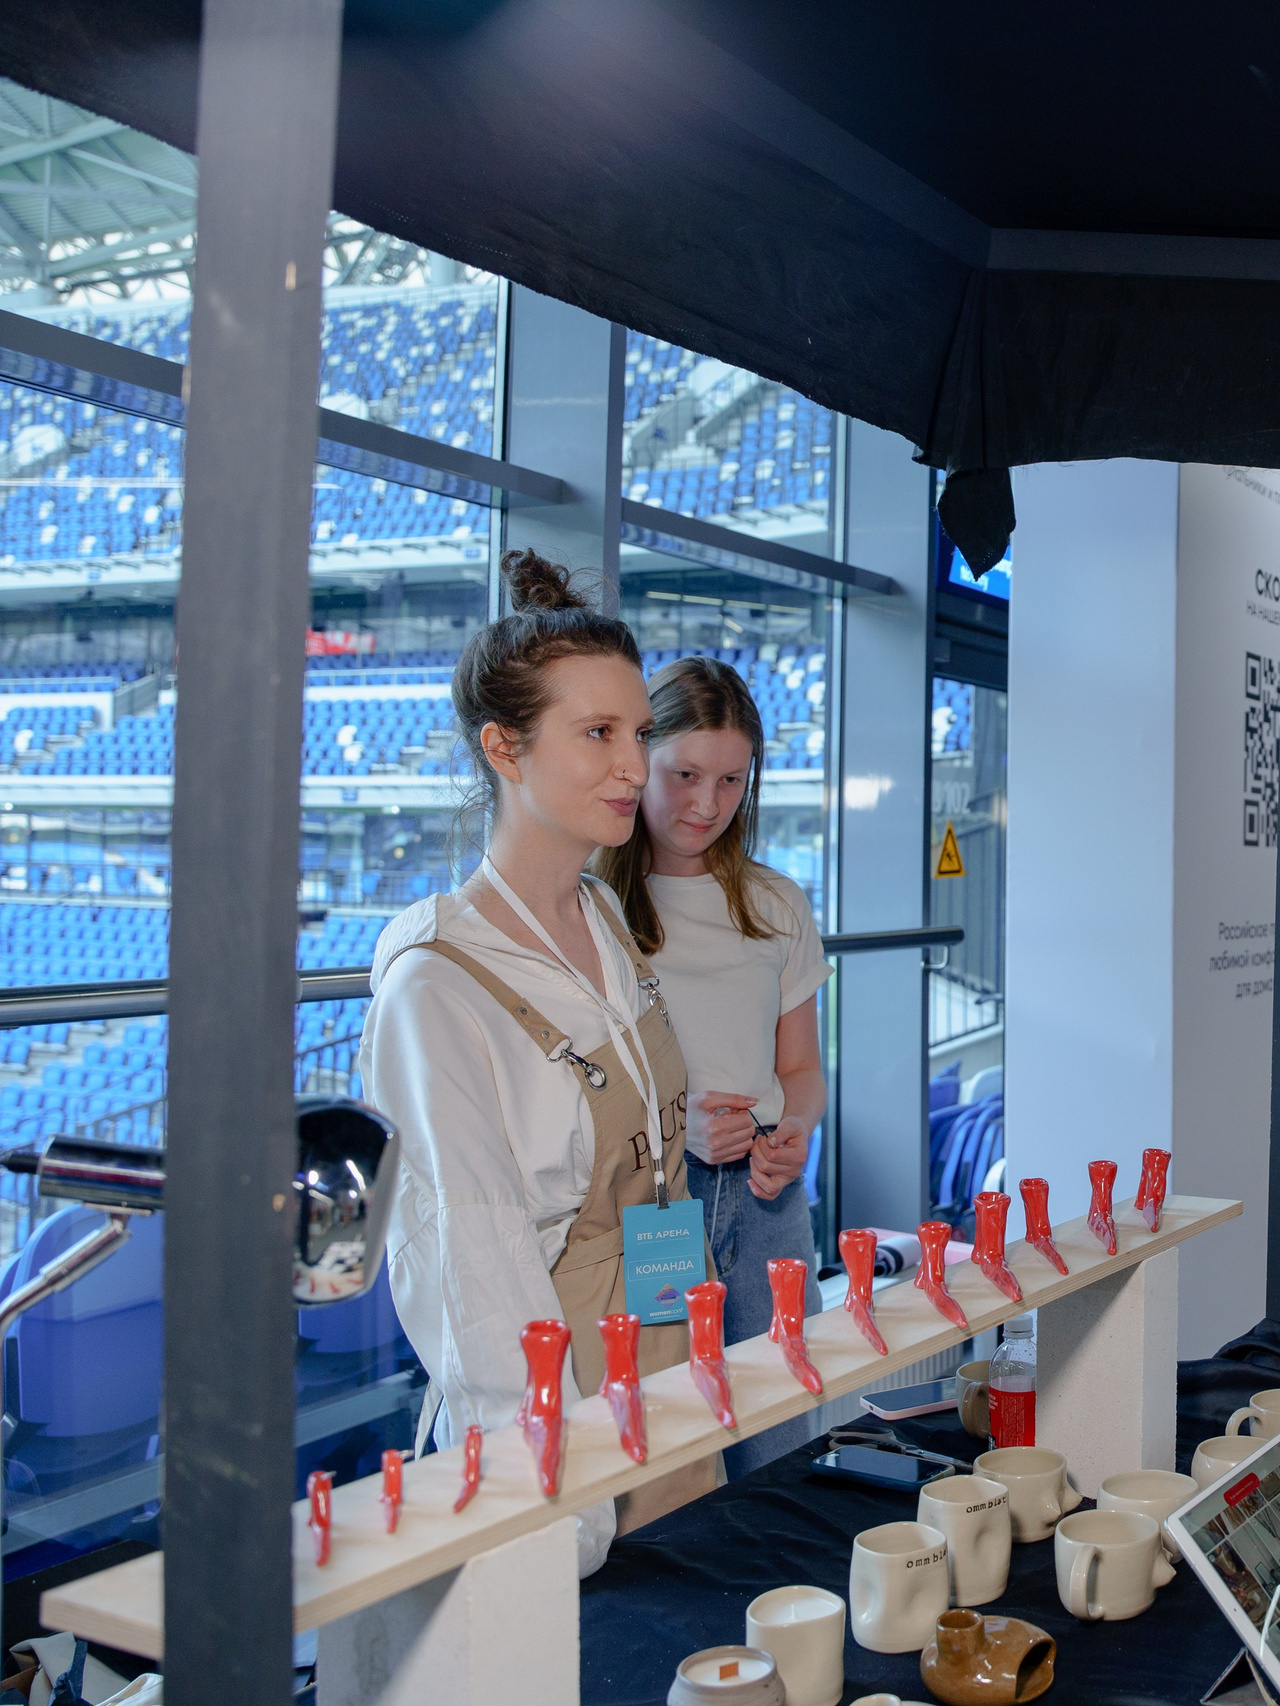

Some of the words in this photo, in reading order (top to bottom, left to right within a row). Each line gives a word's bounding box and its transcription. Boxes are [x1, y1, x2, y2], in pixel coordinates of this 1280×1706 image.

[1219, 921, 1268, 940] Российское
[1208, 949, 1249, 972] любимой
[1236, 981, 1251, 1000] для
[637, 1232, 653, 1241] ВТБ
[655, 1228, 690, 1240] АРЕНА
[635, 1260, 694, 1275] КОМАНДА
